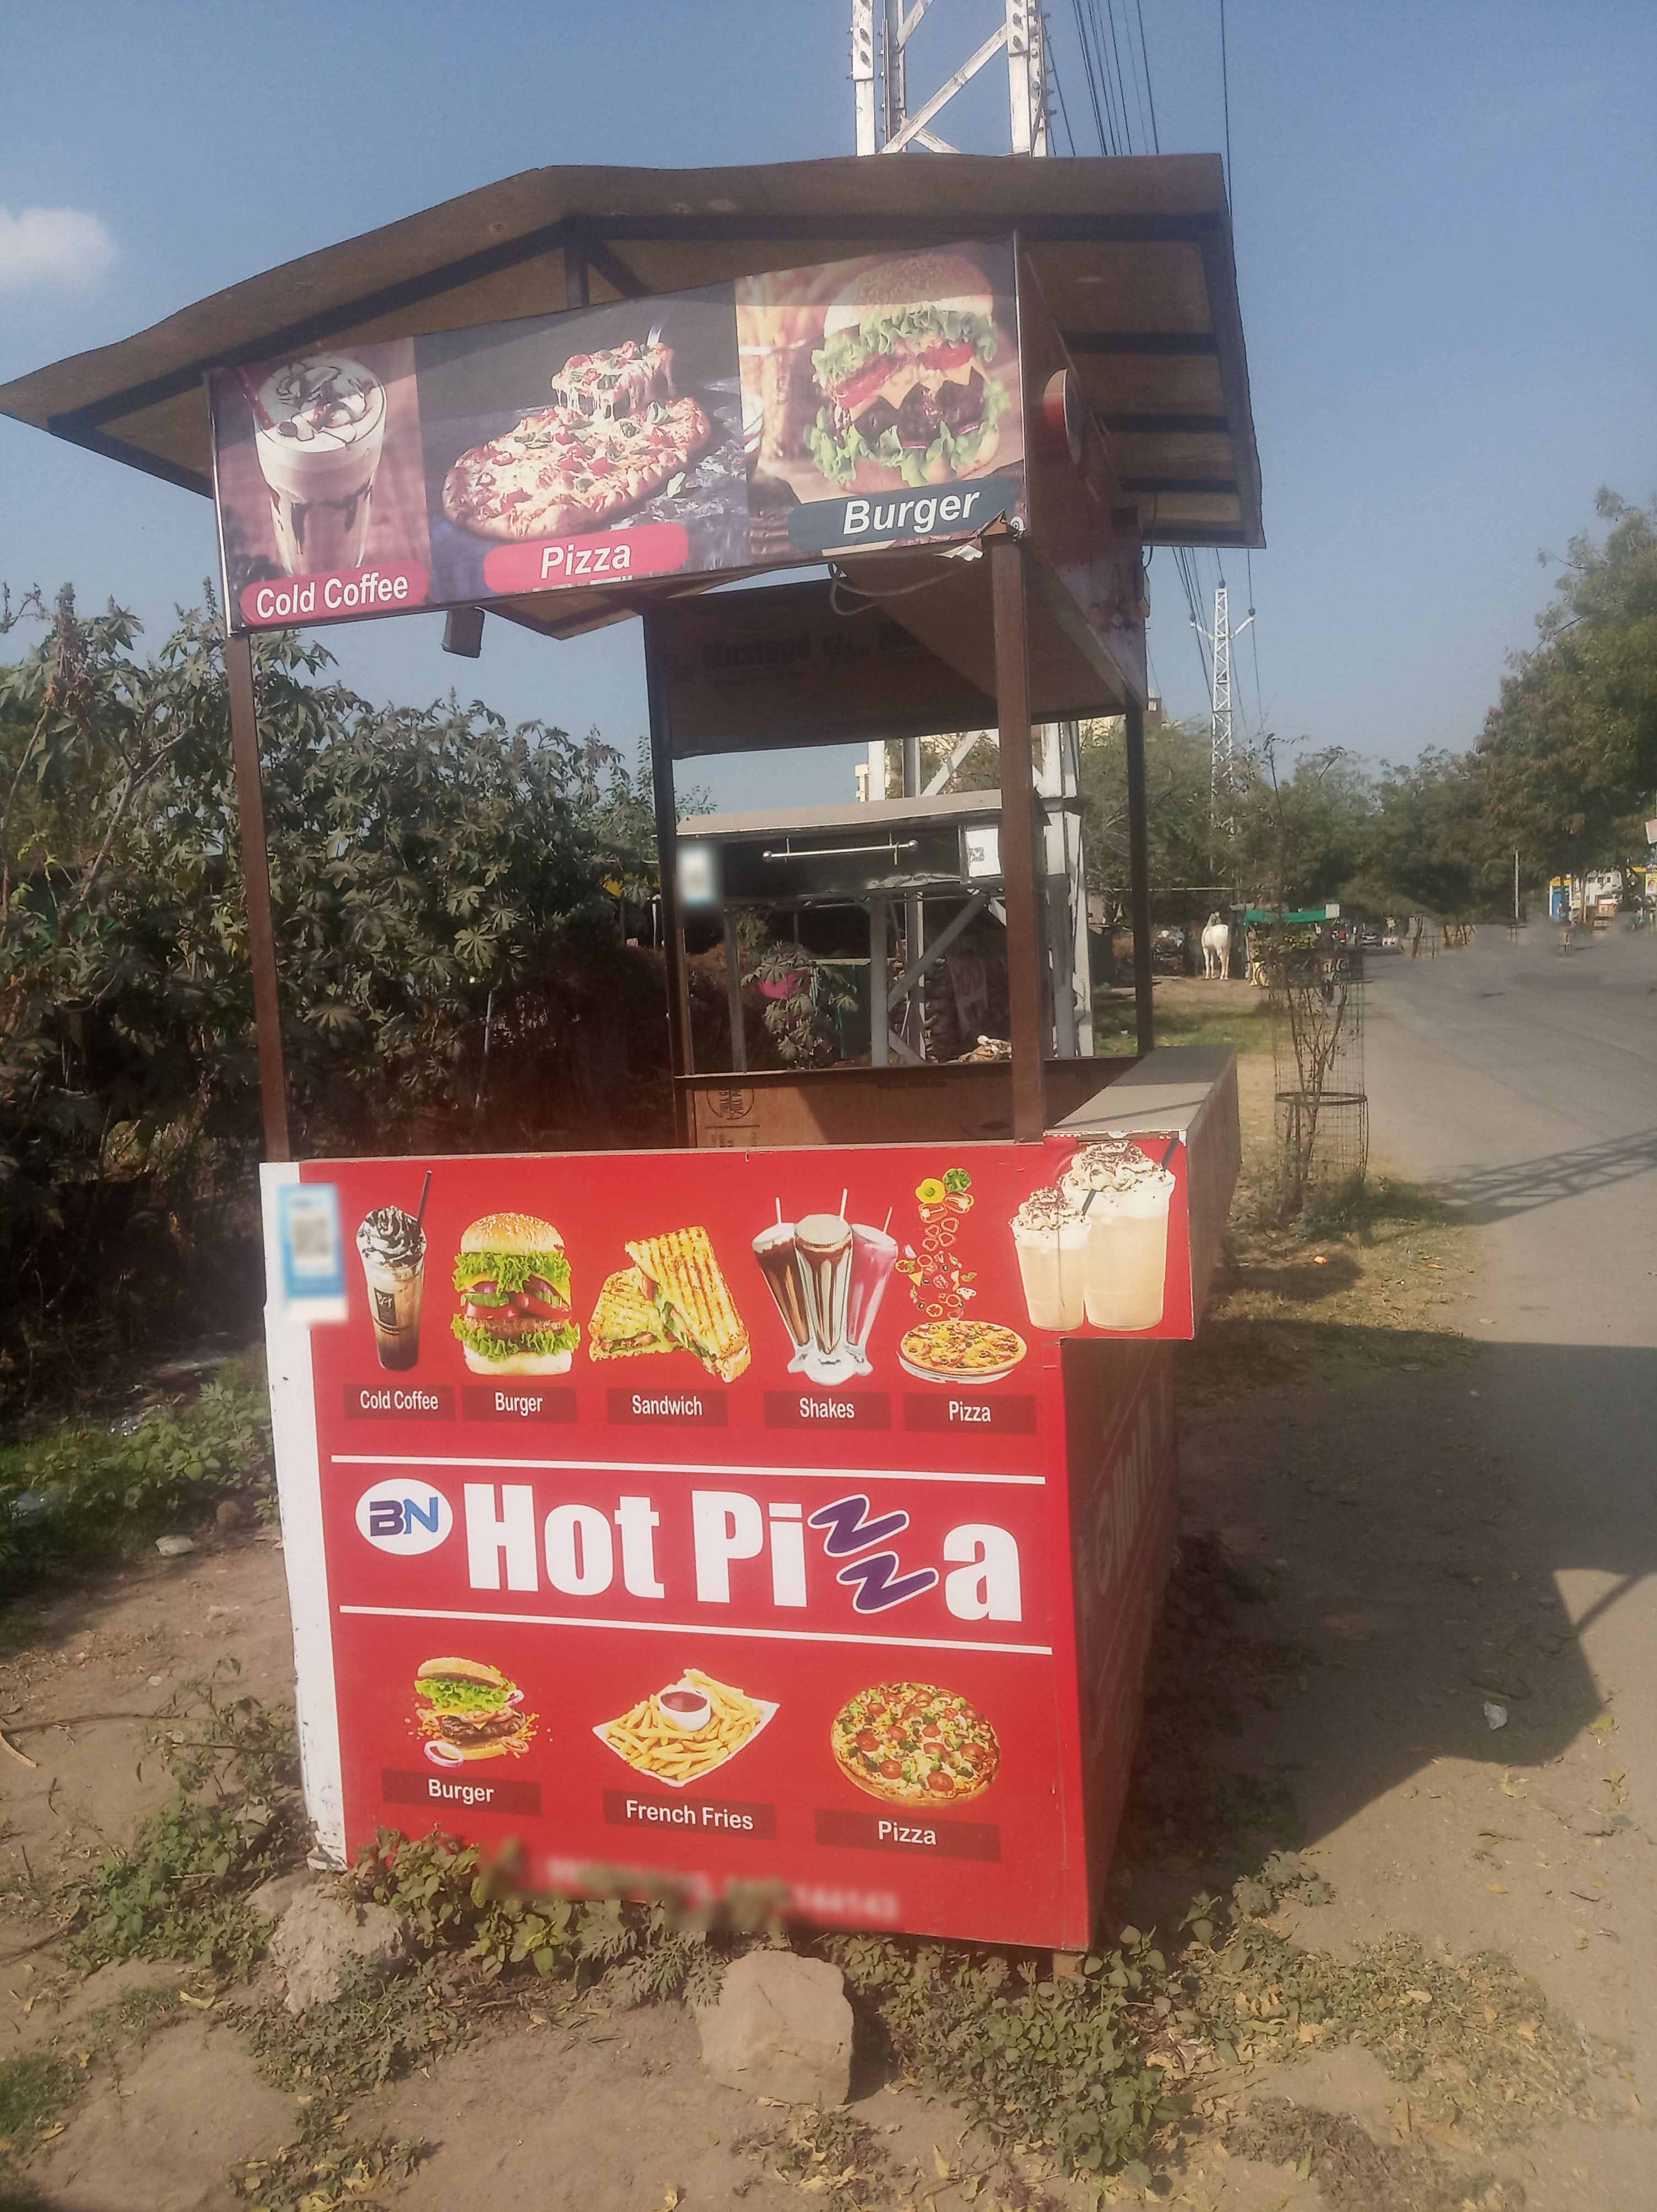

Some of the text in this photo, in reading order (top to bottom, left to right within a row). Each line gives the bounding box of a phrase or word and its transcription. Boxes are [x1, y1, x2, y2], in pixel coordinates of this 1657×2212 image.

[842, 490, 980, 535] Burger
[540, 544, 632, 579] Pizza
[256, 572, 408, 619] Cold Coffee
[360, 1390, 438, 1411] Cold Coffee
[495, 1391, 543, 1417] Burger
[632, 1394, 702, 1416] Sandwich
[799, 1397, 855, 1419] Shakes
[949, 1400, 992, 1423] Pizza
[370, 1483, 1022, 1622] BN Hot Pizza
[428, 1779, 494, 1805] Burger
[626, 1799, 754, 1830] French Fries
[878, 1820, 937, 1846] Pizza
